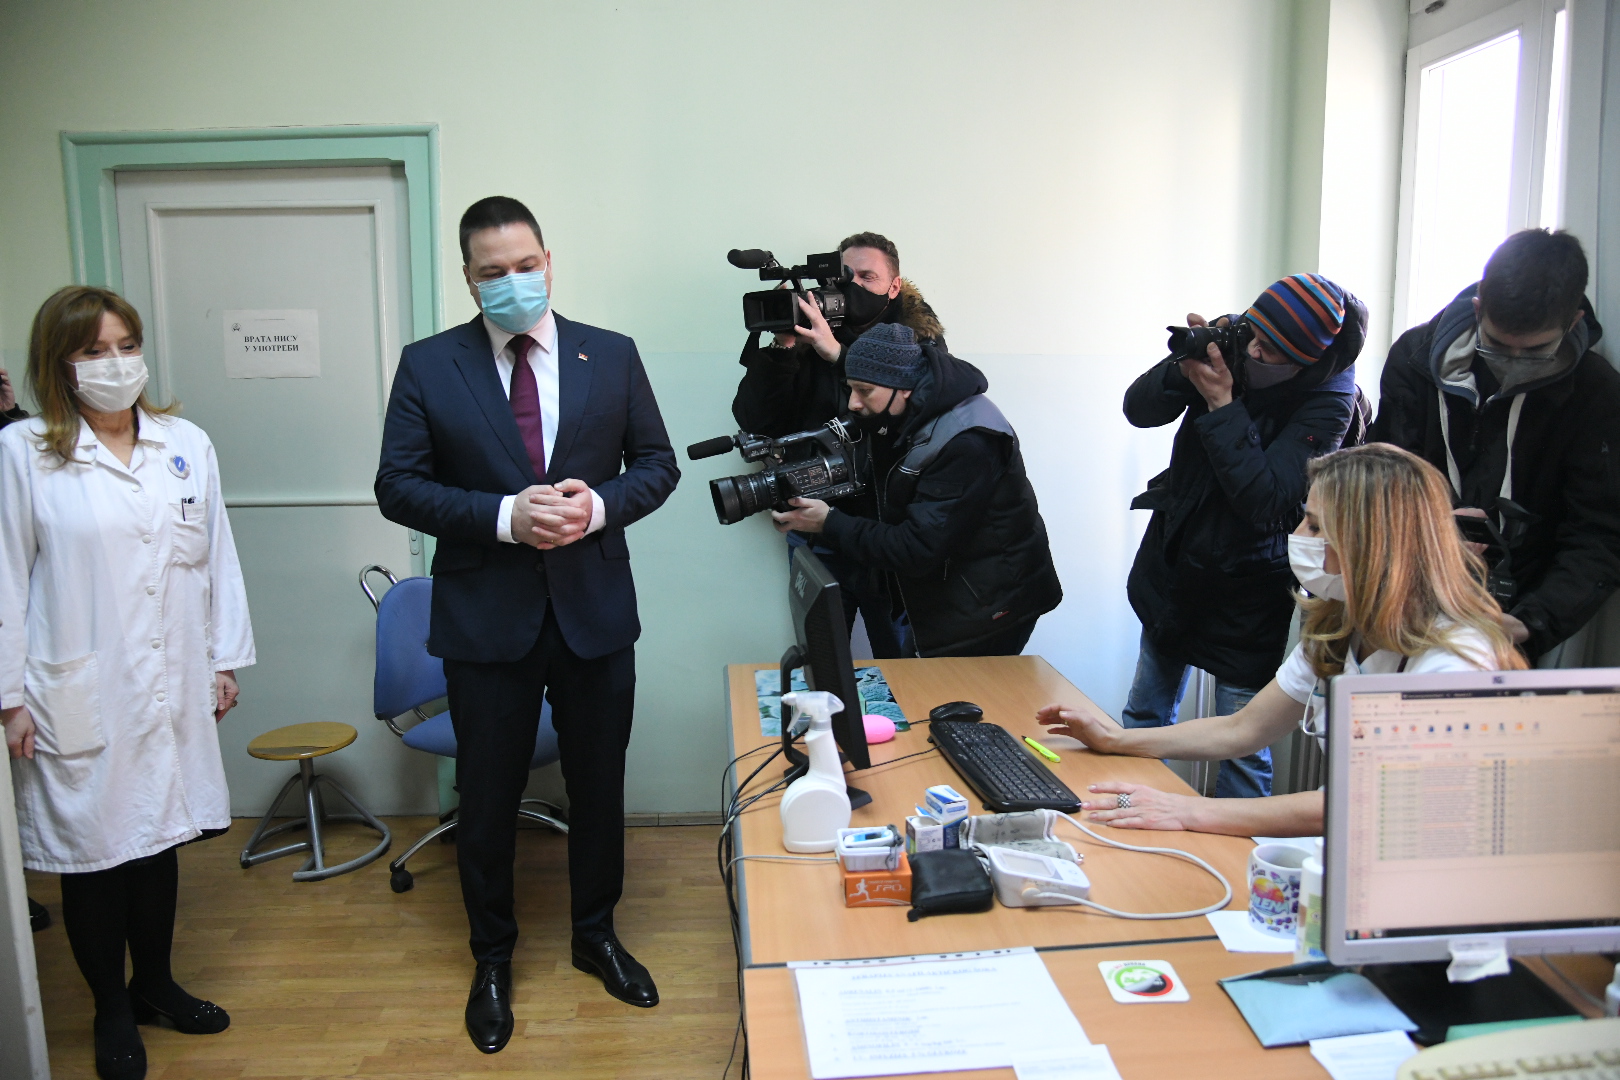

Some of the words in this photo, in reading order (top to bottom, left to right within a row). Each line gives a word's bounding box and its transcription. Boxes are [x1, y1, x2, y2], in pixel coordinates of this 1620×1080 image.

[244, 335, 272, 343] ВРАТА
[244, 345, 251, 353] У
[252, 344, 299, 352] УПОТРЕБИ
